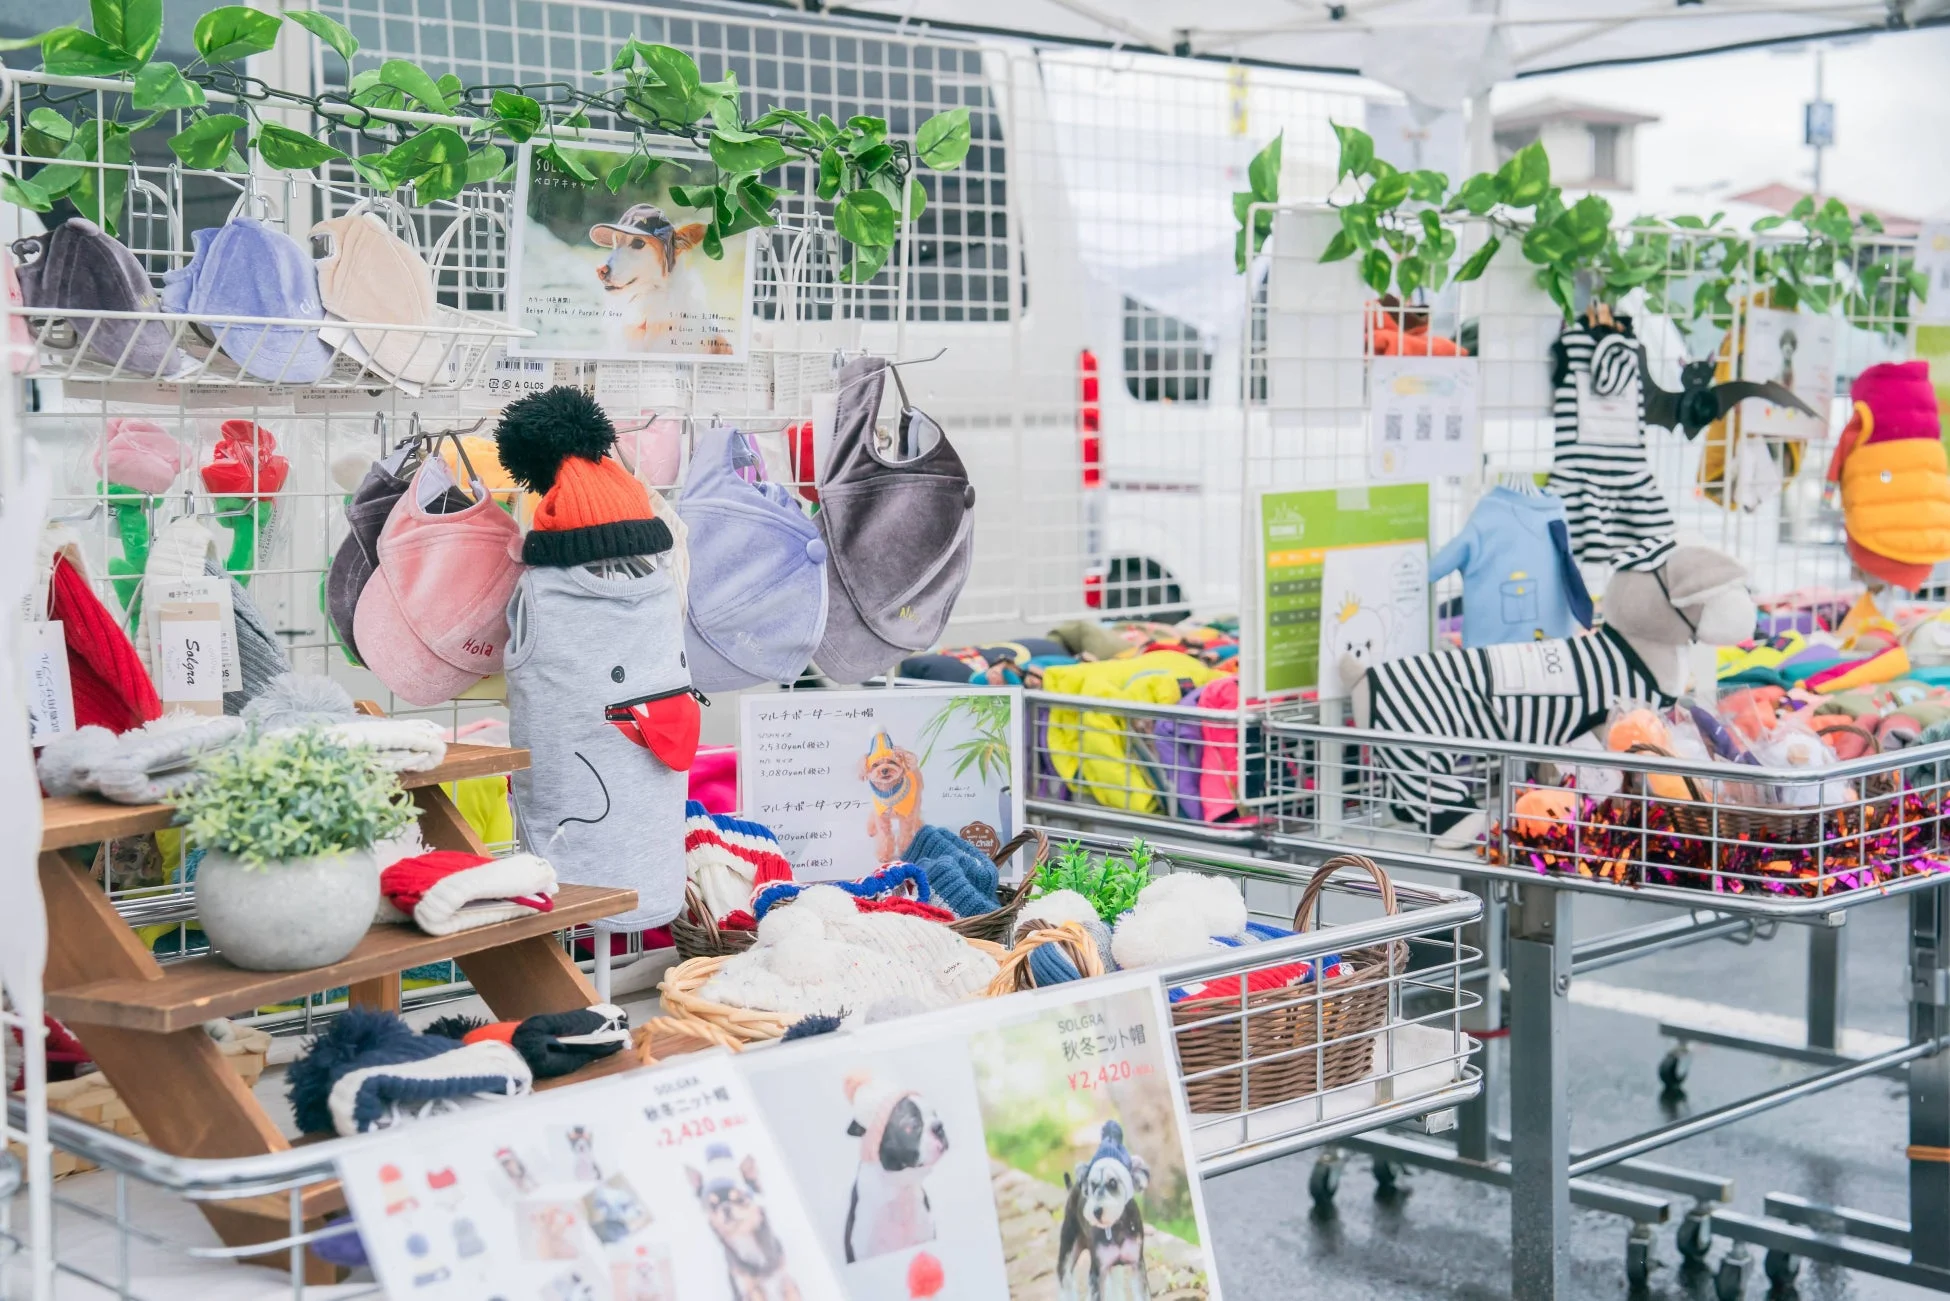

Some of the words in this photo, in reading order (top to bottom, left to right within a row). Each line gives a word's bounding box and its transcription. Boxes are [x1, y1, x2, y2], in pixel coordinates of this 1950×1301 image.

[536, 158, 564, 173] SOL
[534, 177, 597, 190] ベロアキャッ
[526, 306, 544, 314] Beige
[578, 309, 599, 317] Purple
[462, 637, 493, 657] Hola
[181, 638, 200, 685] Solgra
[758, 707, 874, 721] マルチボーダーニット帽
[761, 799, 871, 814] マルチボーダーマフラー
[1058, 1013, 1105, 1034] SOLGRA
[1062, 1024, 1146, 1062] 秋冬ニット帽
[1067, 1060, 1131, 1091] ¥2,420
